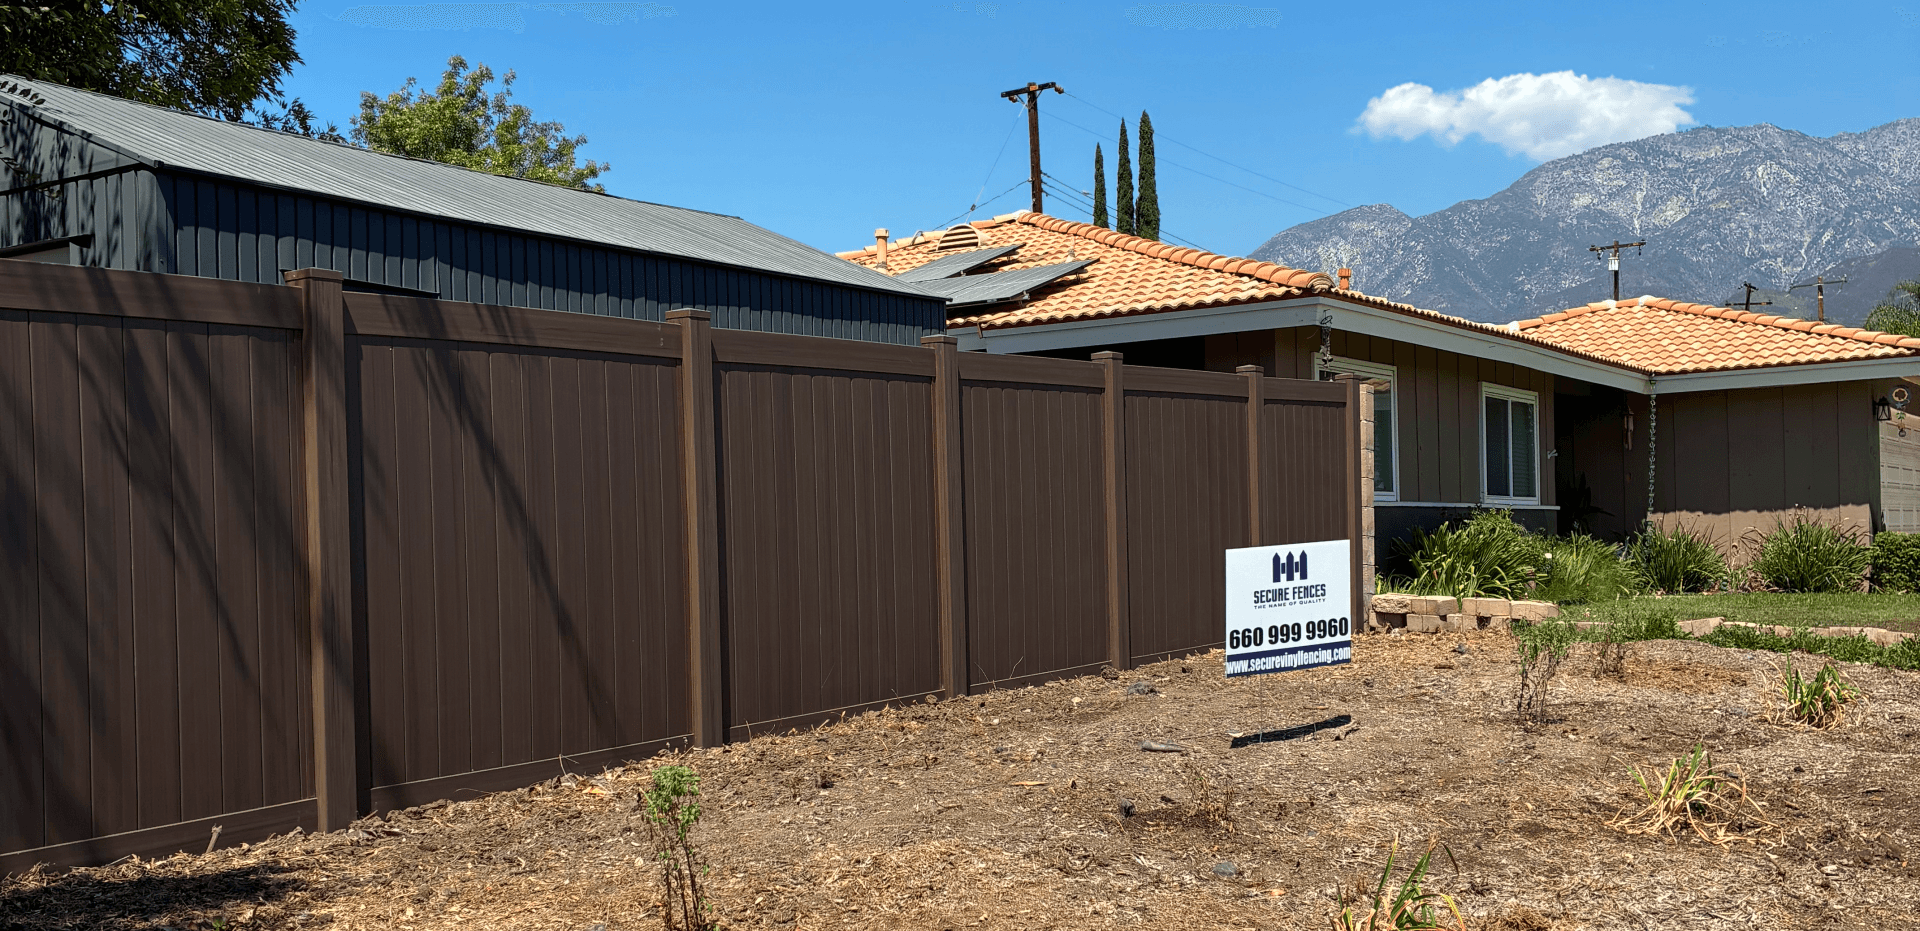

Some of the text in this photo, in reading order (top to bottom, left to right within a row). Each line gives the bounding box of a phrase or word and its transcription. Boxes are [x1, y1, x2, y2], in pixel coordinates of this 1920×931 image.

[1254, 584, 1326, 604] SECURE FENCES
[1229, 617, 1349, 649] 660 999 9960
[1226, 646, 1351, 674] www.securevinylfencing.com
